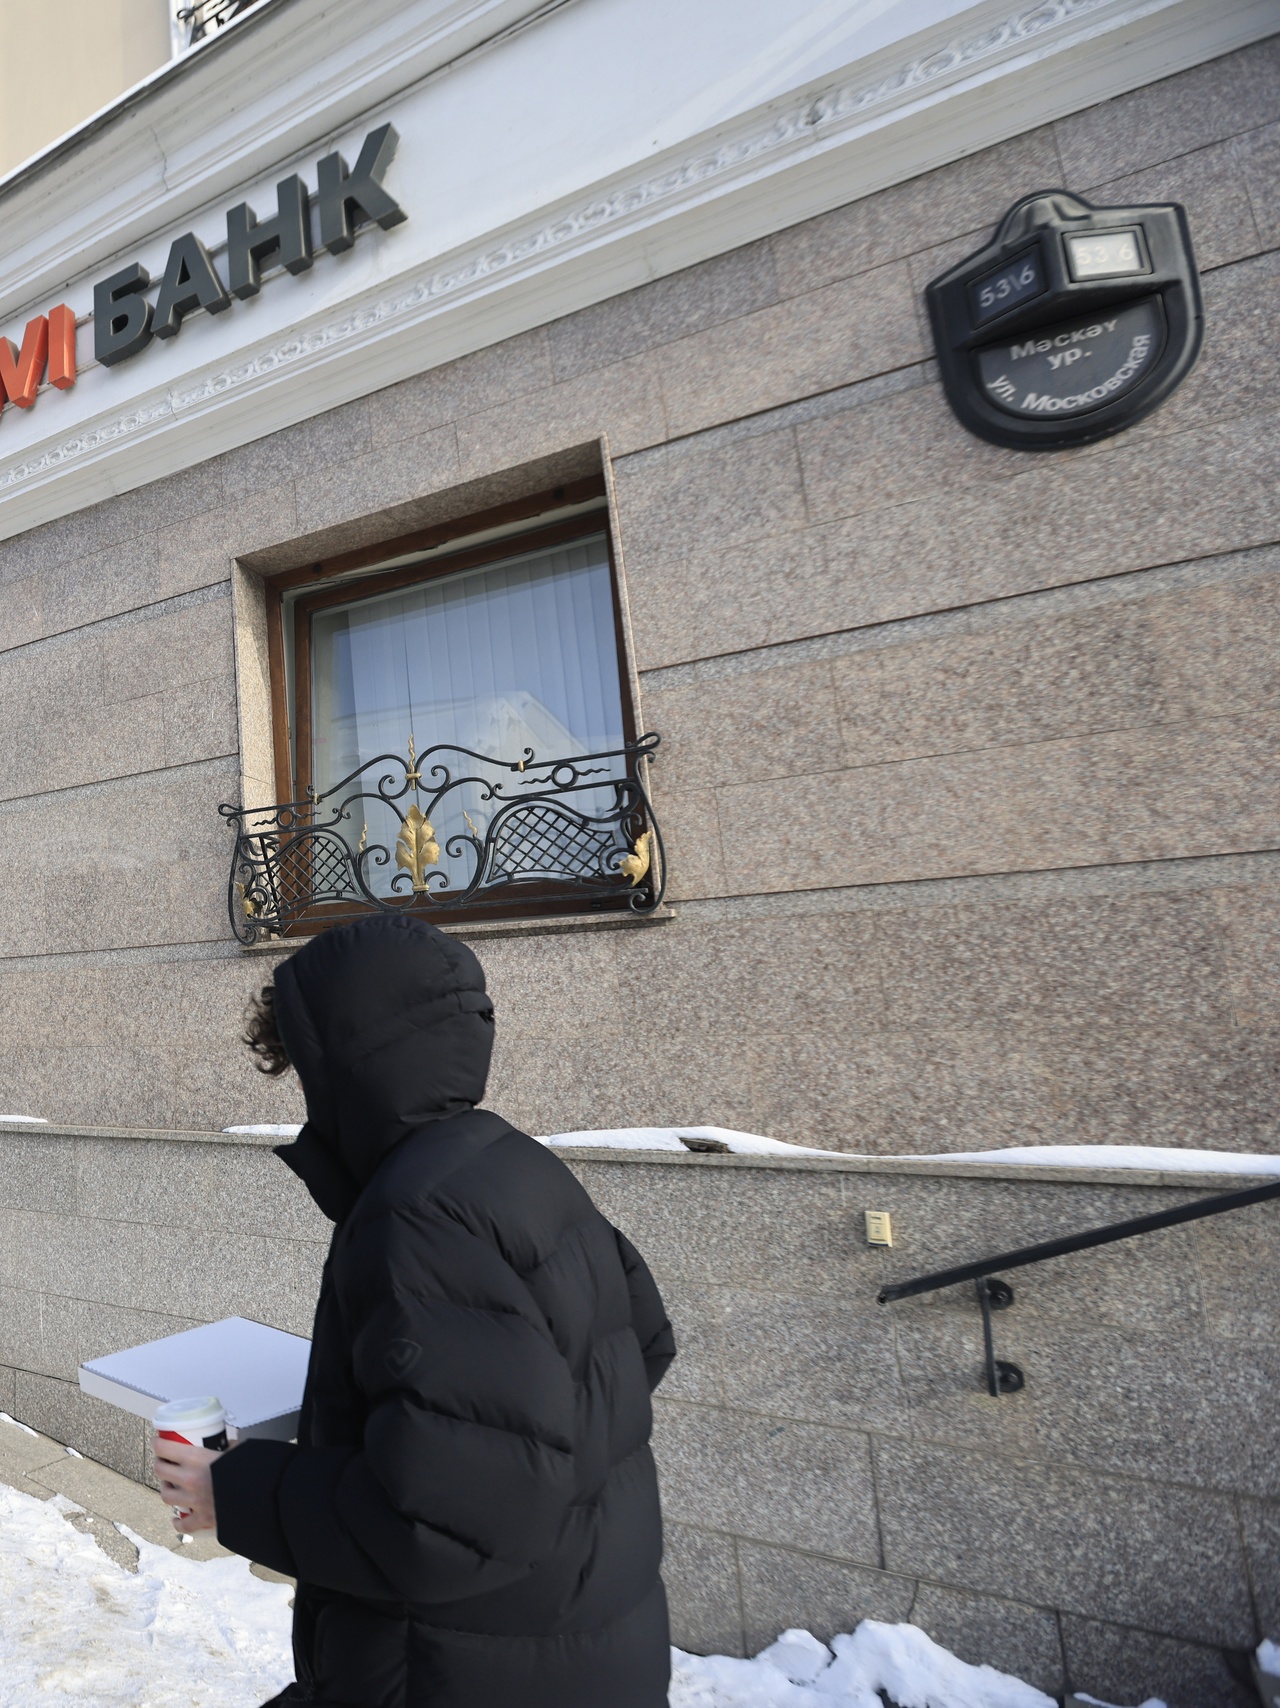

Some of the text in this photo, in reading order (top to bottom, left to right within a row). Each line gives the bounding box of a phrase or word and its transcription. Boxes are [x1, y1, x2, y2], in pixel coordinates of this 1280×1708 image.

[94, 122, 408, 367] БАНК
[986, 334, 1150, 411] ул. Московская
[1046, 348, 1092, 370] ур.
